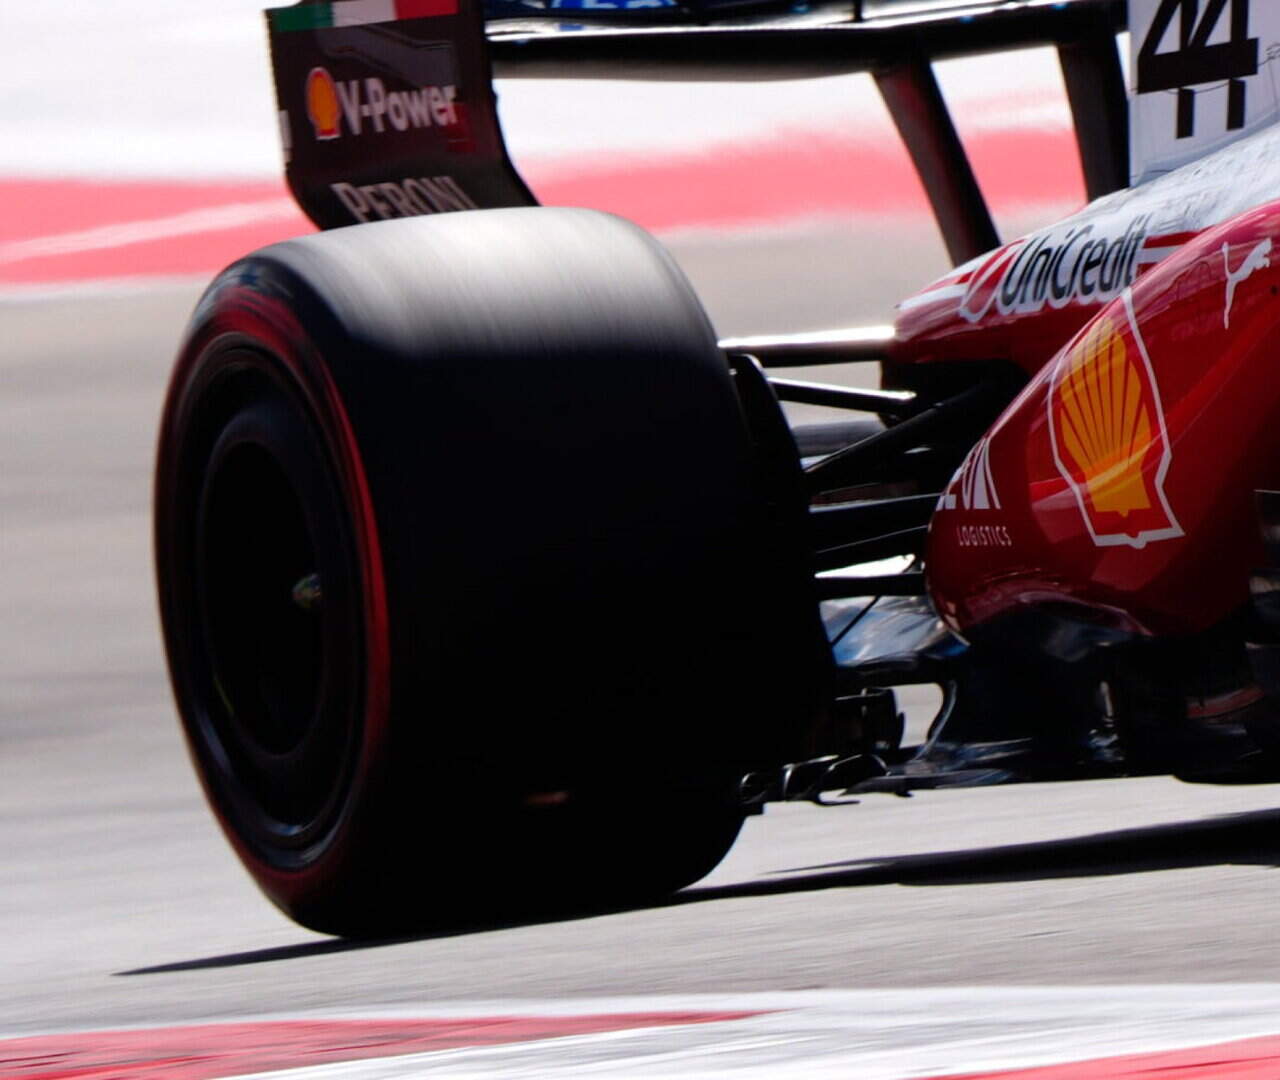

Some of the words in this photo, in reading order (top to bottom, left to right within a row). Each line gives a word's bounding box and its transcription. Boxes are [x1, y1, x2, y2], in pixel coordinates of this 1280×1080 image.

[334, 77, 458, 136] V-Power
[1001, 213, 1153, 308] UniCredit
[956, 525, 1013, 547] LOGISTICS
